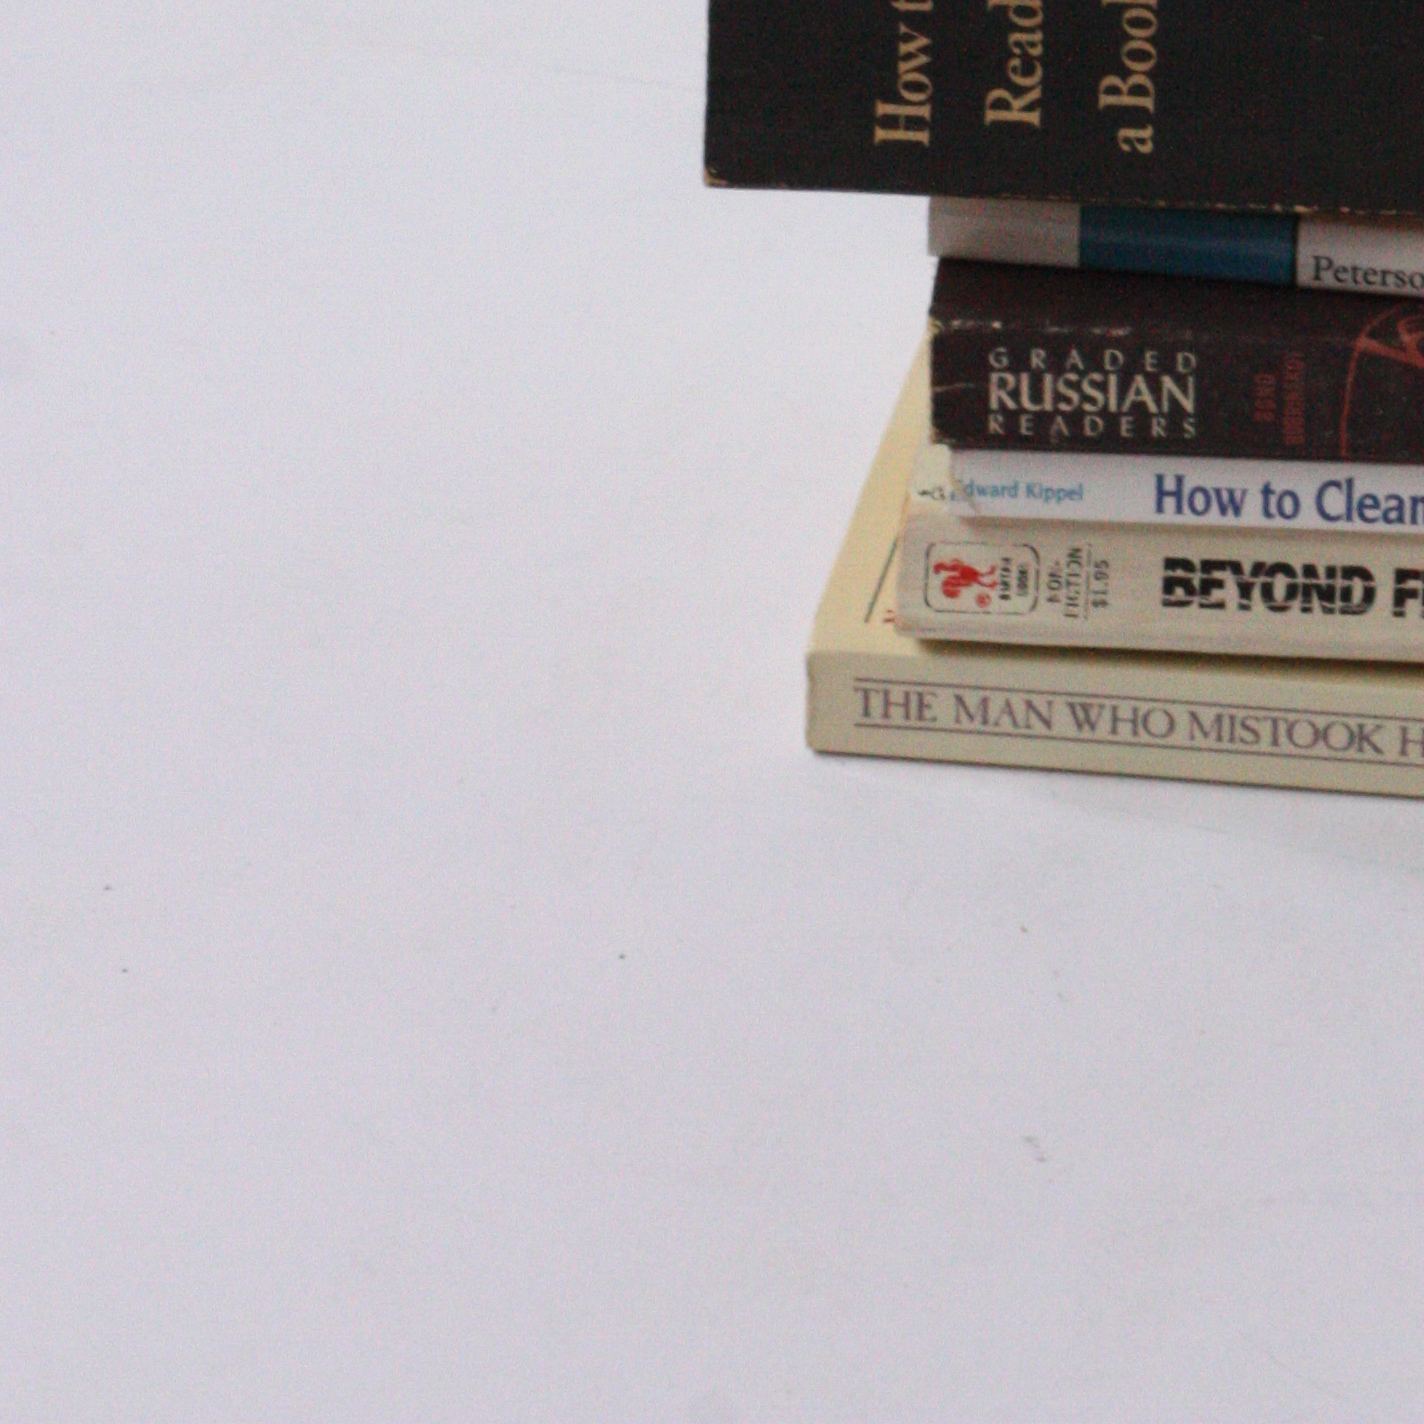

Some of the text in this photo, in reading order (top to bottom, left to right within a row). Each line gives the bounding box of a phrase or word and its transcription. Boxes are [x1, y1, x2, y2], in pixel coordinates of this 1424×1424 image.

[873, 21, 934, 148] How
[1116, 124, 1154, 154] a
[987, 347, 1198, 373] GRADED
[987, 371, 1198, 415] RUSSIAN
[987, 413, 1198, 440] READERS
[1025, 481, 1084, 504] Kippel
[1152, 472, 1248, 518] How
[1260, 480, 1301, 521] to
[1161, 557, 1378, 615] BEYOND
[853, 686, 938, 723] THE
[953, 692, 1054, 732] MAN
[1066, 700, 1175, 739] WHO
[1187, 709, 1385, 755] MISTOOK
